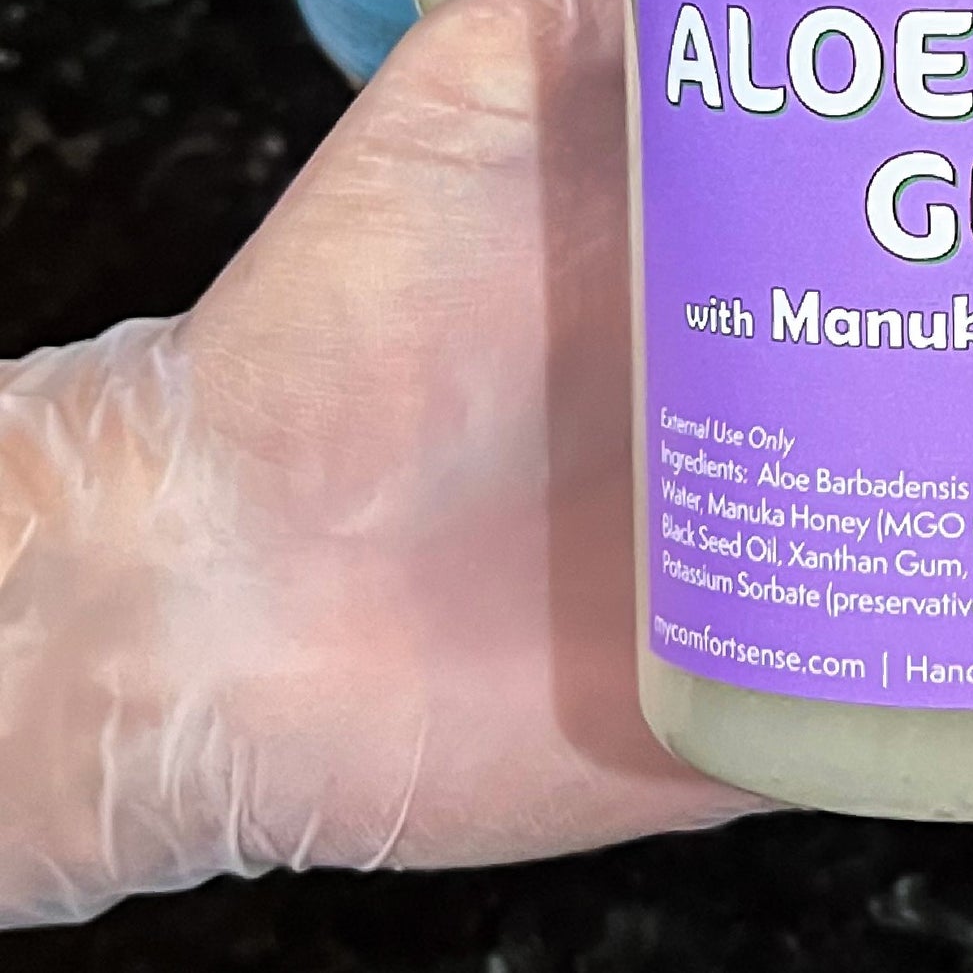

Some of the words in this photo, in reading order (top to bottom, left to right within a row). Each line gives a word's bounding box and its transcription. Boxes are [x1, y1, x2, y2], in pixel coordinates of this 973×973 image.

[684, 295, 755, 339] with
[660, 406, 711, 440] External
[713, 419, 744, 446] Use
[748, 425, 796, 459] Only
[660, 440, 748, 484] Ingredients:
[756, 461, 810, 492] Aloe
[816, 467, 970, 500] Barbadensis
[661, 476, 704, 516] Water,
[707, 492, 785, 527] Manuka
[791, 503, 871, 544] Honey
[876, 508, 966, 545] (MGO
[661, 512, 696, 547] Black
[698, 525, 742, 559] Seed
[745, 535, 783, 567] Oil,
[787, 540, 888, 575] Xanthan
[894, 549, 969, 580] Gum,
[661, 550, 734, 594] Potassium
[737, 570, 820, 608] Sorbate
[653, 614, 866, 679] mycomfortsense.com
